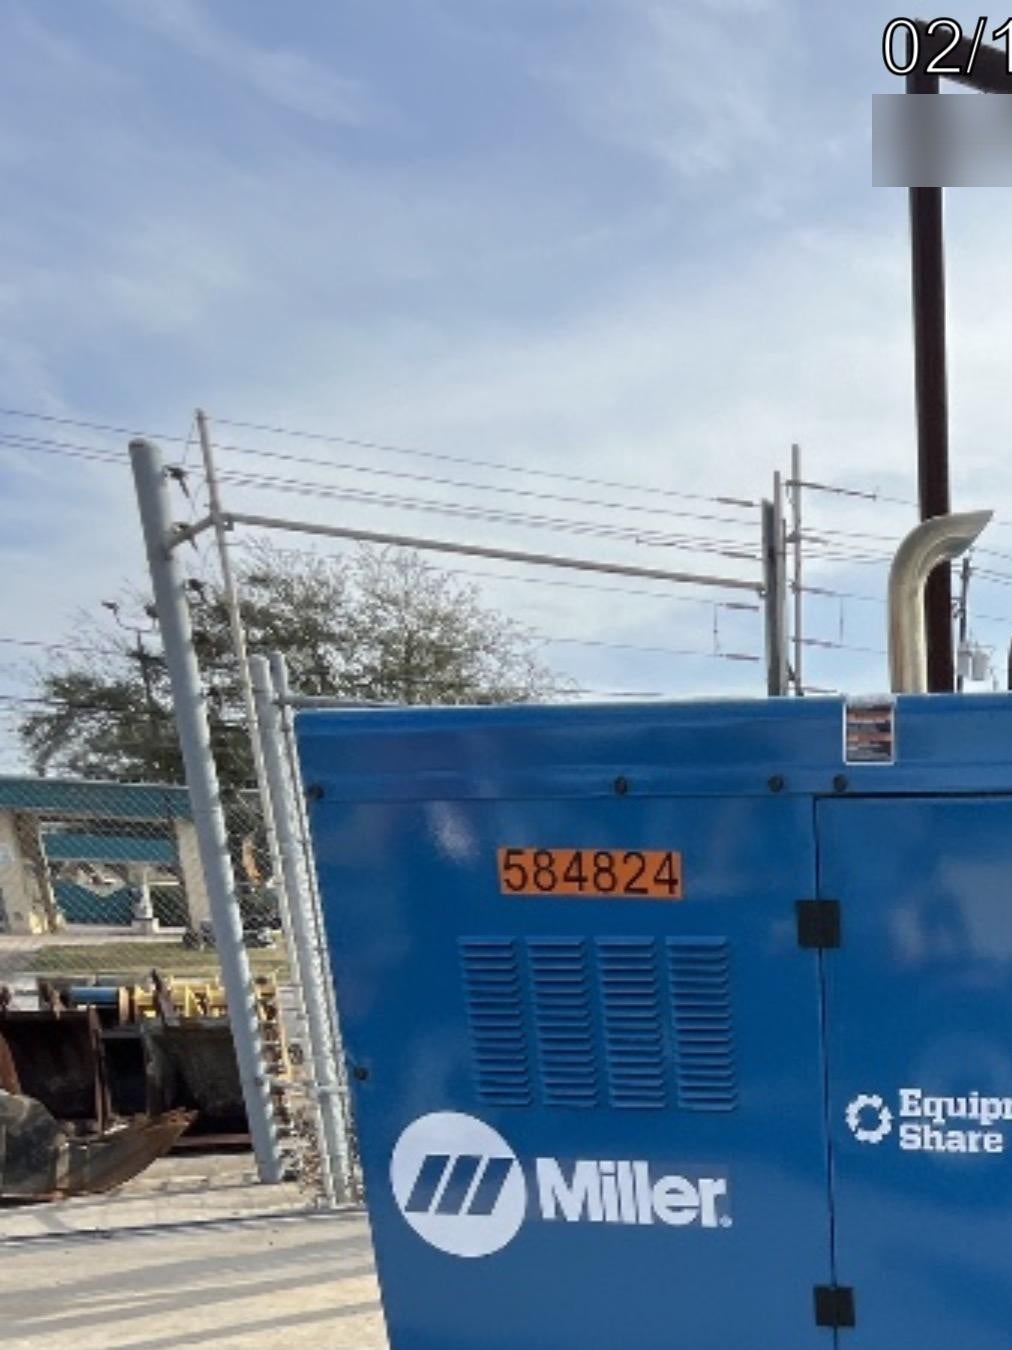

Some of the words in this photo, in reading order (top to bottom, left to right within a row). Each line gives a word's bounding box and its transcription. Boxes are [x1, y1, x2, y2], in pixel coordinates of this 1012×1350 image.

[503, 849, 679, 895] 584824
[899, 1123, 1004, 1153] Share
[535, 1156, 728, 1228] Miller
